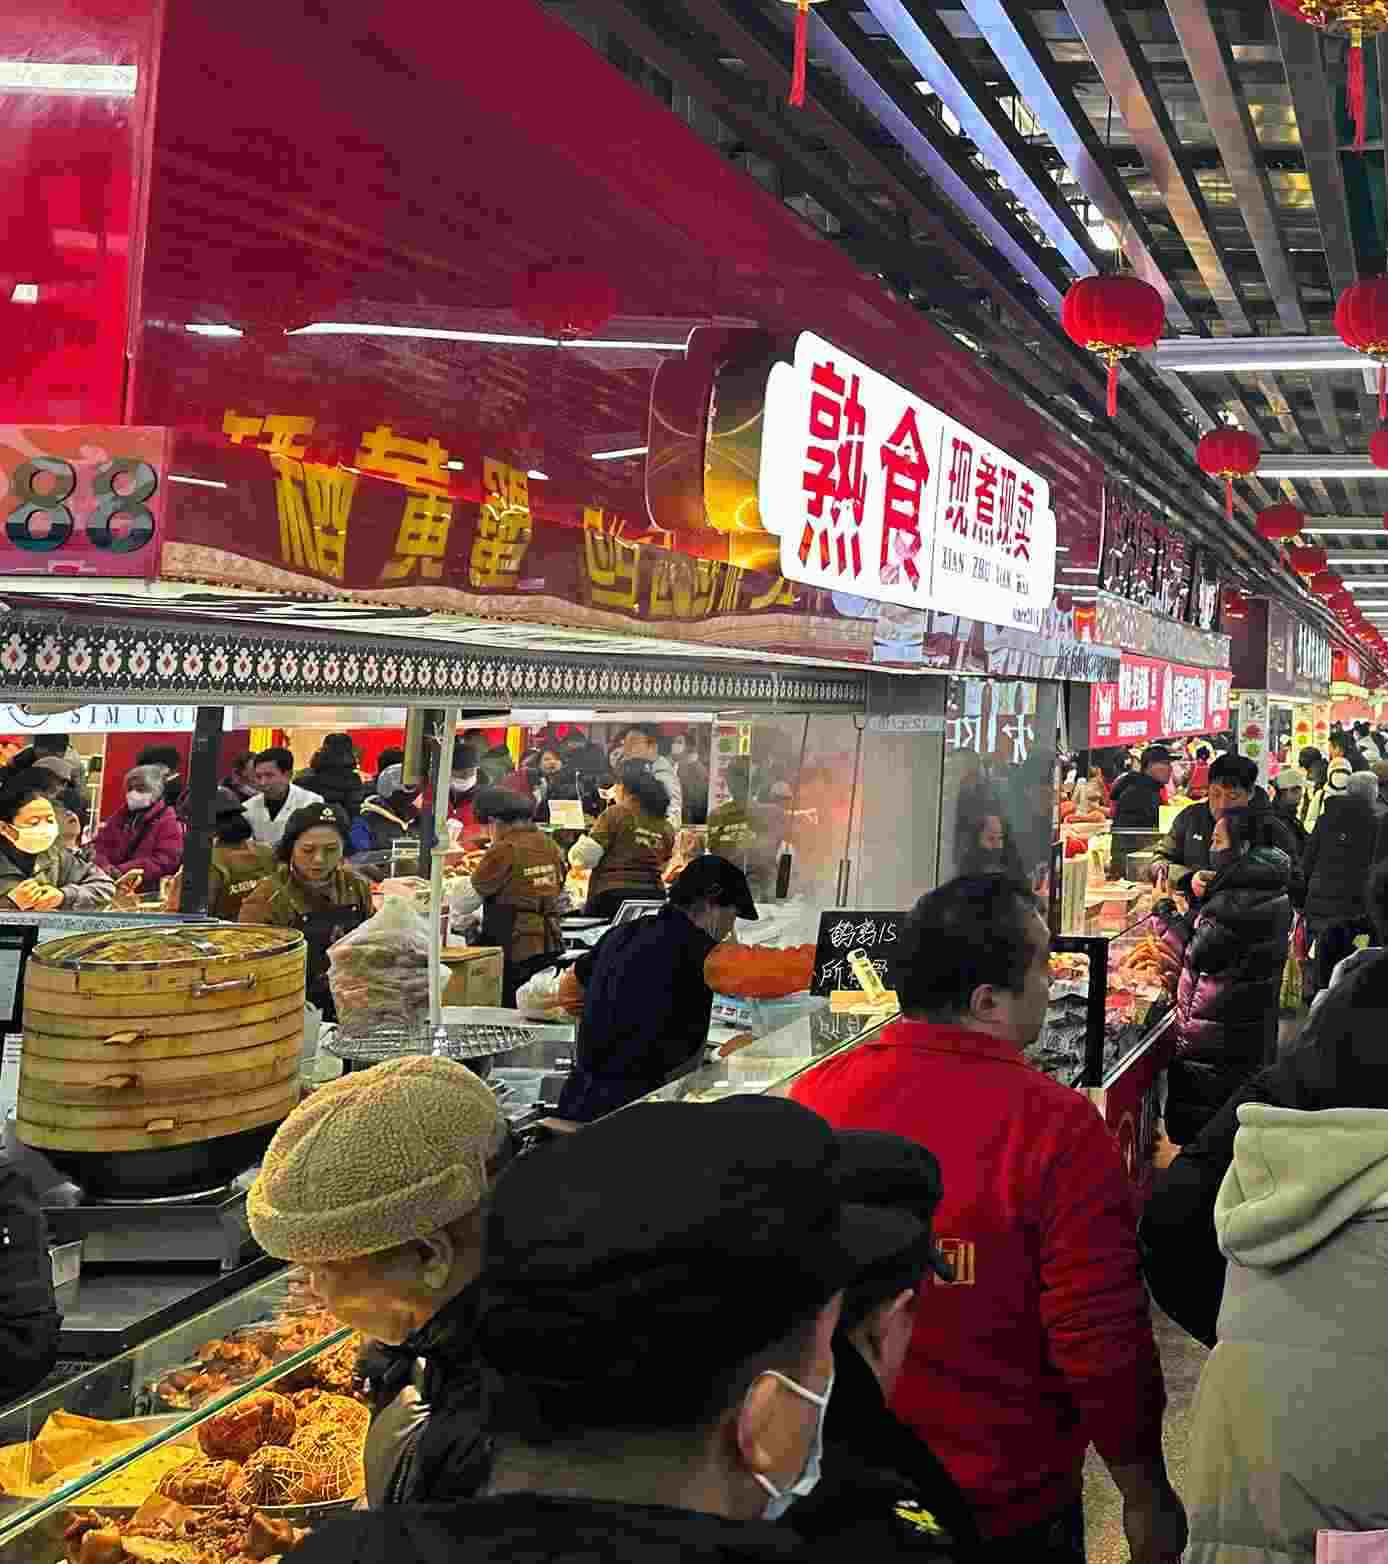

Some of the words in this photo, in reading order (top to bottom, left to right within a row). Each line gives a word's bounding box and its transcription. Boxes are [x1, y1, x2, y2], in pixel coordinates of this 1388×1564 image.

[6, 456, 158, 552] 88
[797, 361, 930, 592] 熟食
[945, 437, 1034, 562] 现煮现卖
[71, 706, 120, 726] SIM
